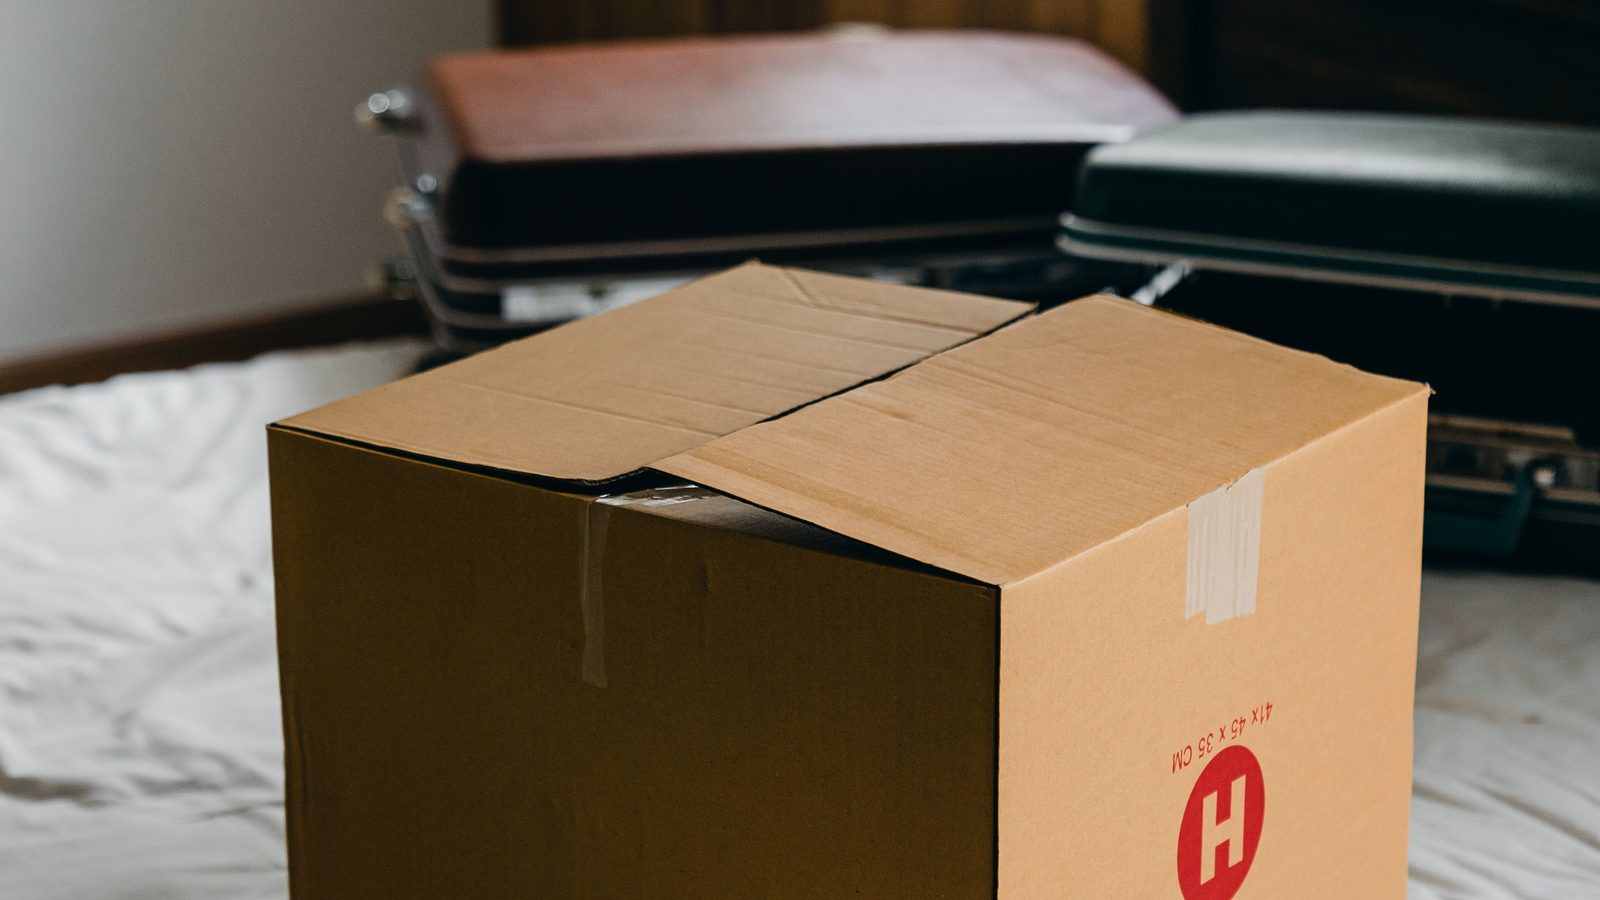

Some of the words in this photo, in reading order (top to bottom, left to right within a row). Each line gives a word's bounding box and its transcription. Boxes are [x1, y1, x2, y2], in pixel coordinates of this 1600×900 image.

[1231, 716, 1246, 740] 45
[1172, 745, 1193, 774] CM
[1198, 733, 1214, 759] 35
[1200, 774, 1247, 886] H
